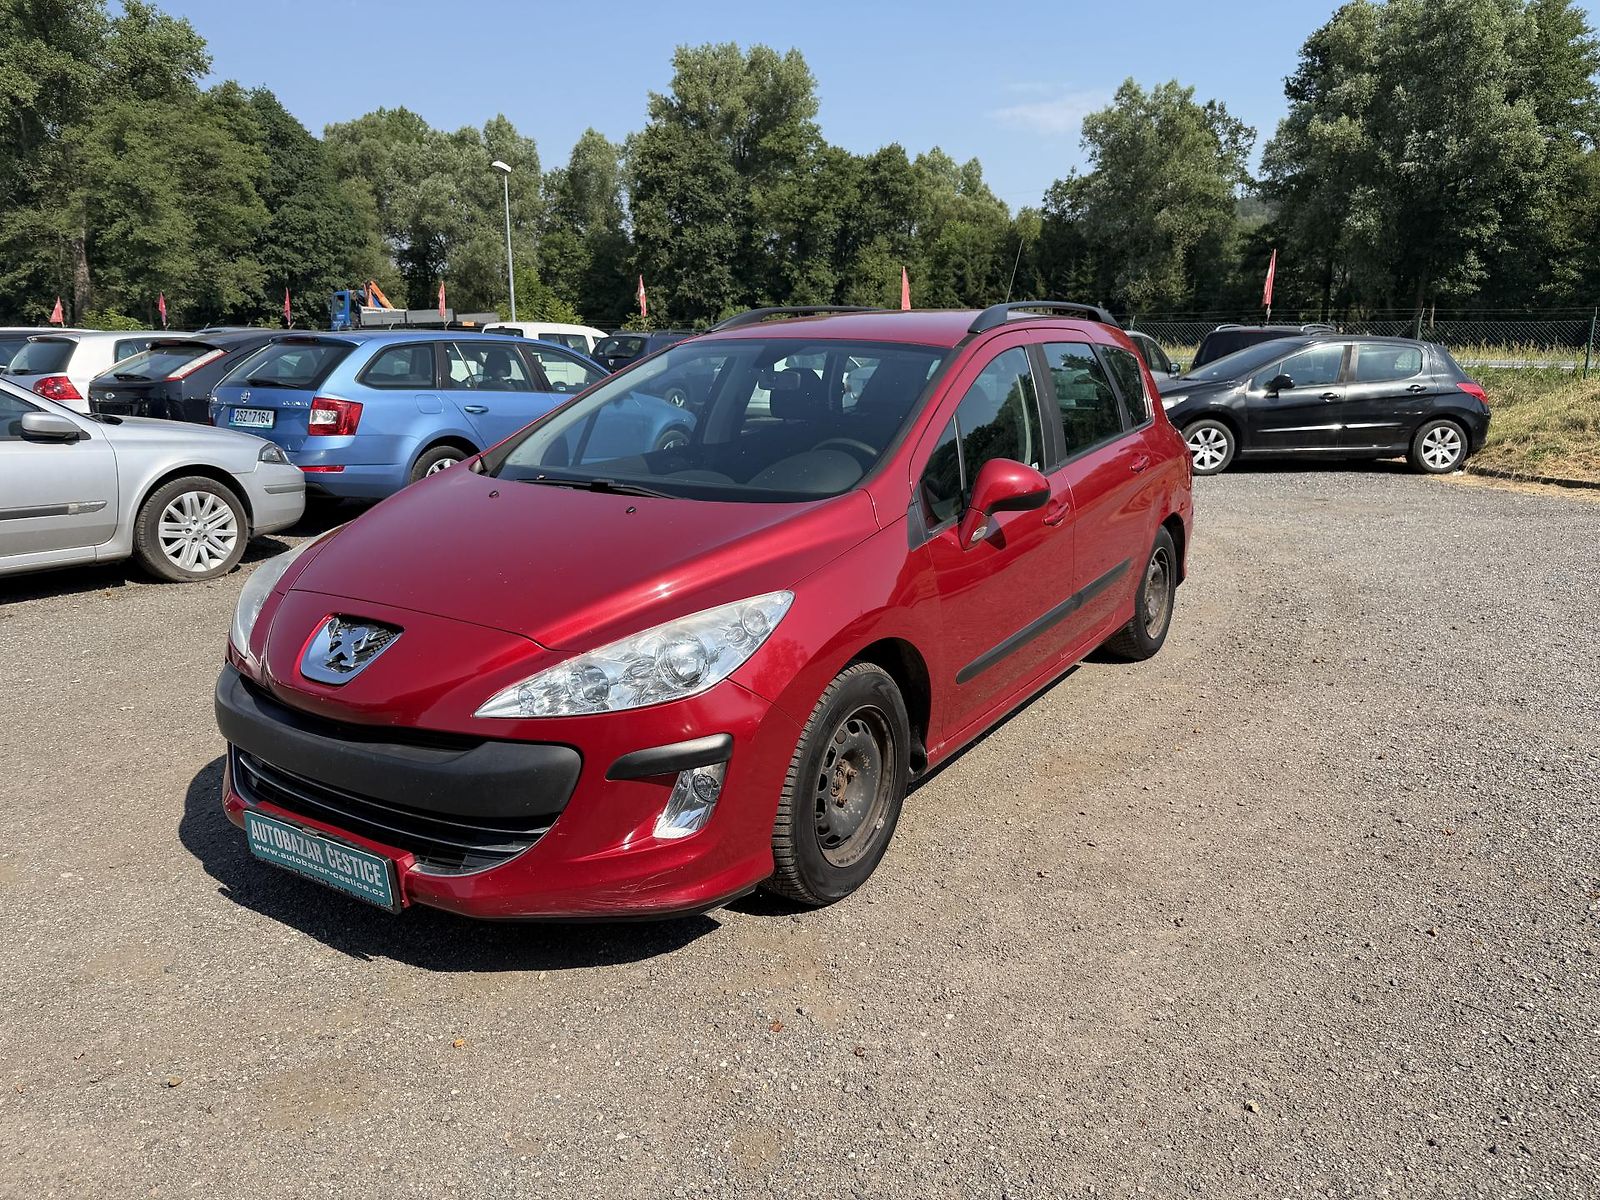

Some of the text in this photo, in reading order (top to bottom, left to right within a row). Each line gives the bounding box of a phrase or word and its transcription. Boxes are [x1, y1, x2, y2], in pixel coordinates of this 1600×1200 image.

[250, 819, 324, 864] AUTOBAZAR
[325, 842, 383, 887] ČESTICE
[254, 842, 385, 898] www.autobazar-cestice.cz
